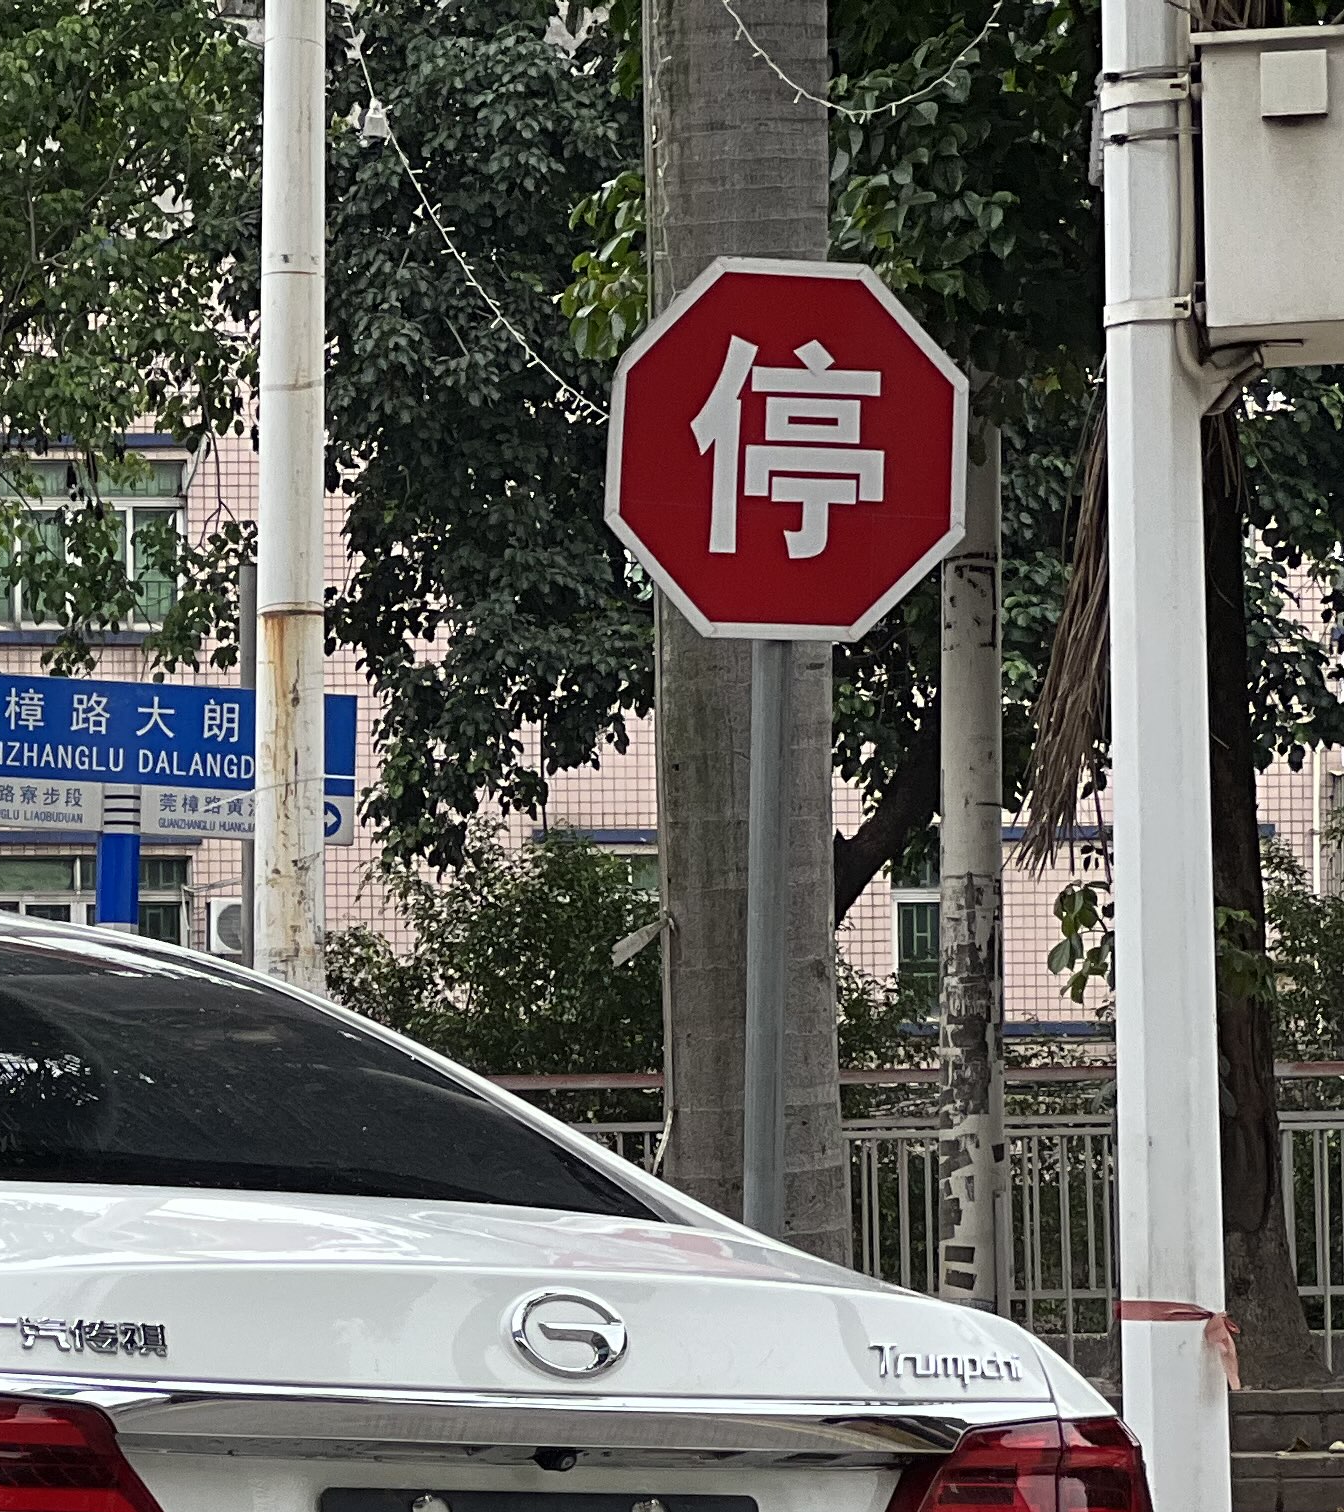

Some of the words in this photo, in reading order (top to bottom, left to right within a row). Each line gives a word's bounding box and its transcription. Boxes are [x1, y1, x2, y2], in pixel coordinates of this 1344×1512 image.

[690, 335, 885, 559] 停
[23, 810, 84, 824] LIAOBUDUAN
[158, 817, 216, 832] GUANZHANGLU
[868, 1342, 1024, 1391] Trumpchi
